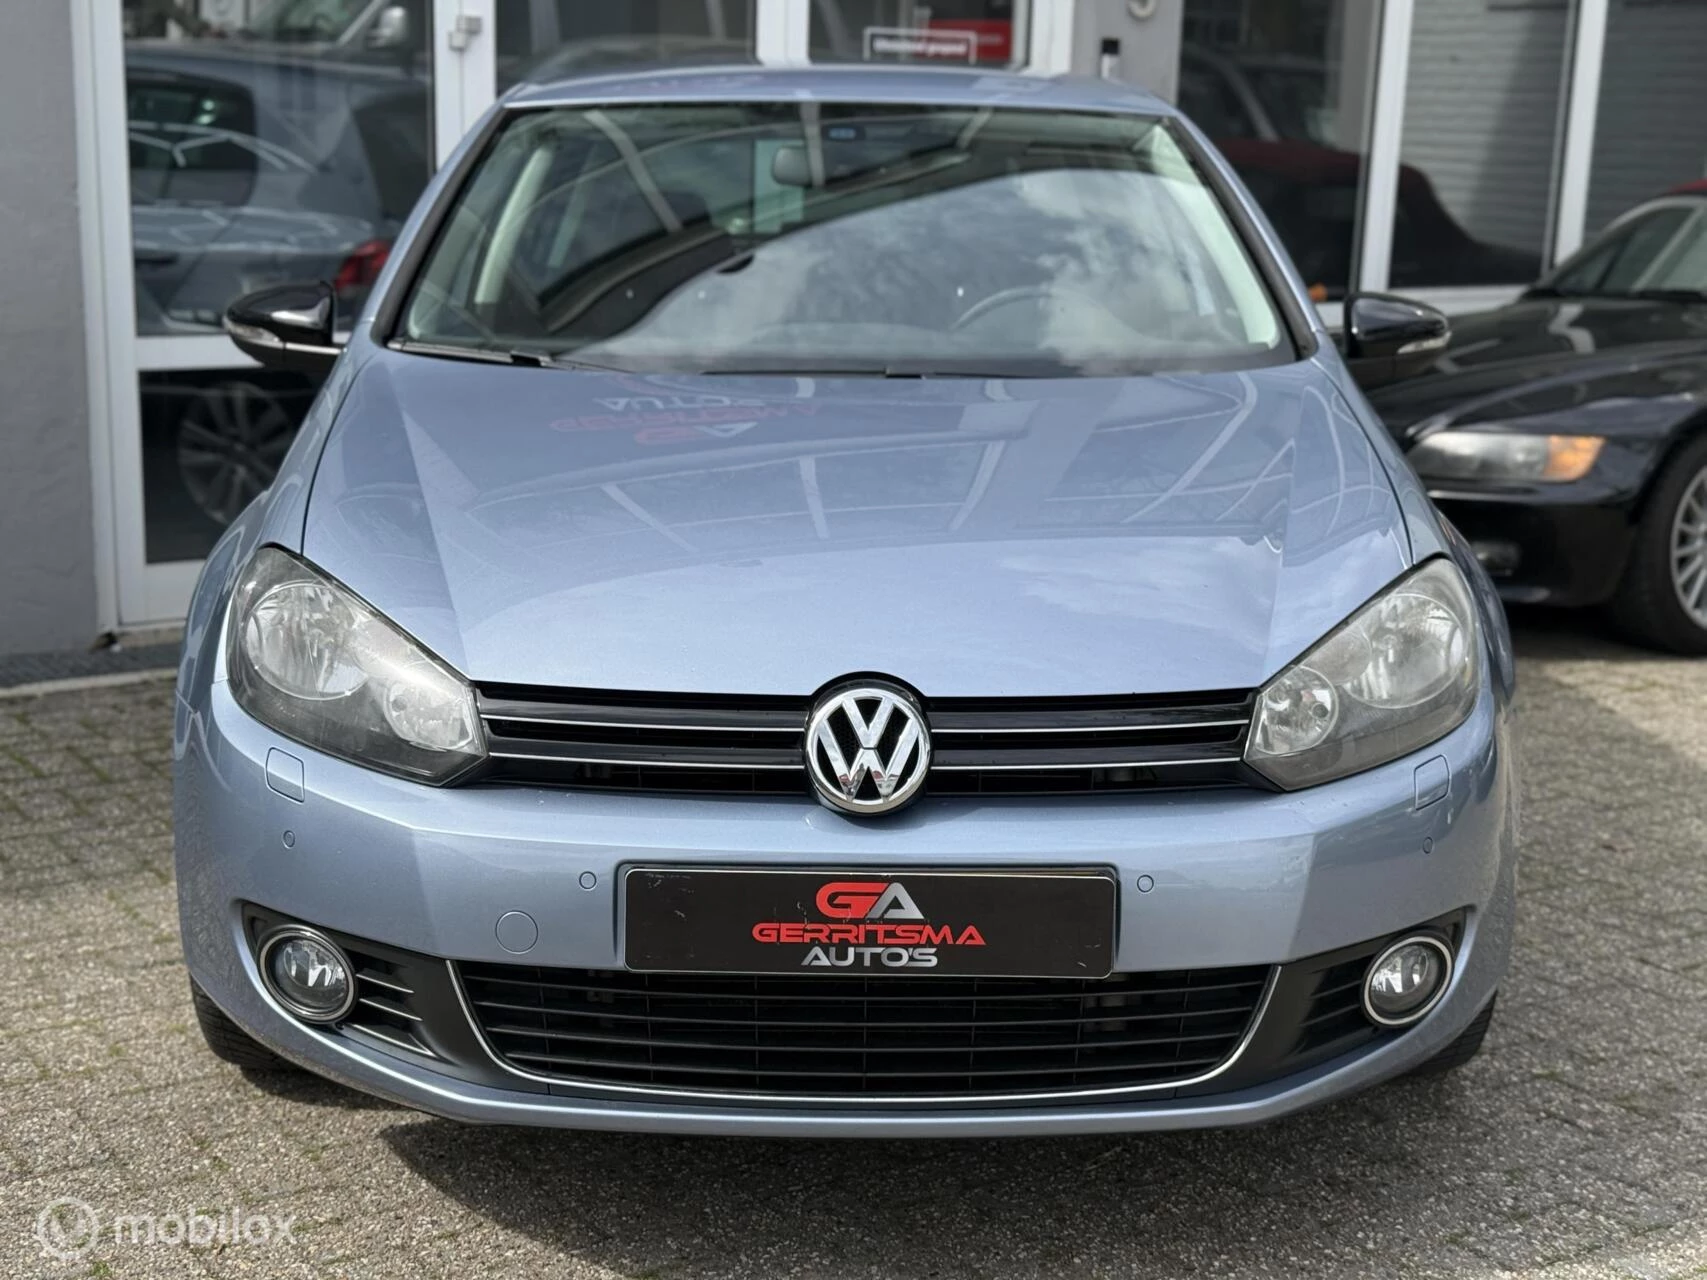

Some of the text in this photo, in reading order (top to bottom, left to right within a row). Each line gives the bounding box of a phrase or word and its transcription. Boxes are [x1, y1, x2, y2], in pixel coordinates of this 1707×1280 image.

[813, 693, 923, 805] VW
[816, 882, 925, 919] GA
[752, 922, 986, 945] GERRITSMA
[801, 946, 938, 967] AUTO'S
